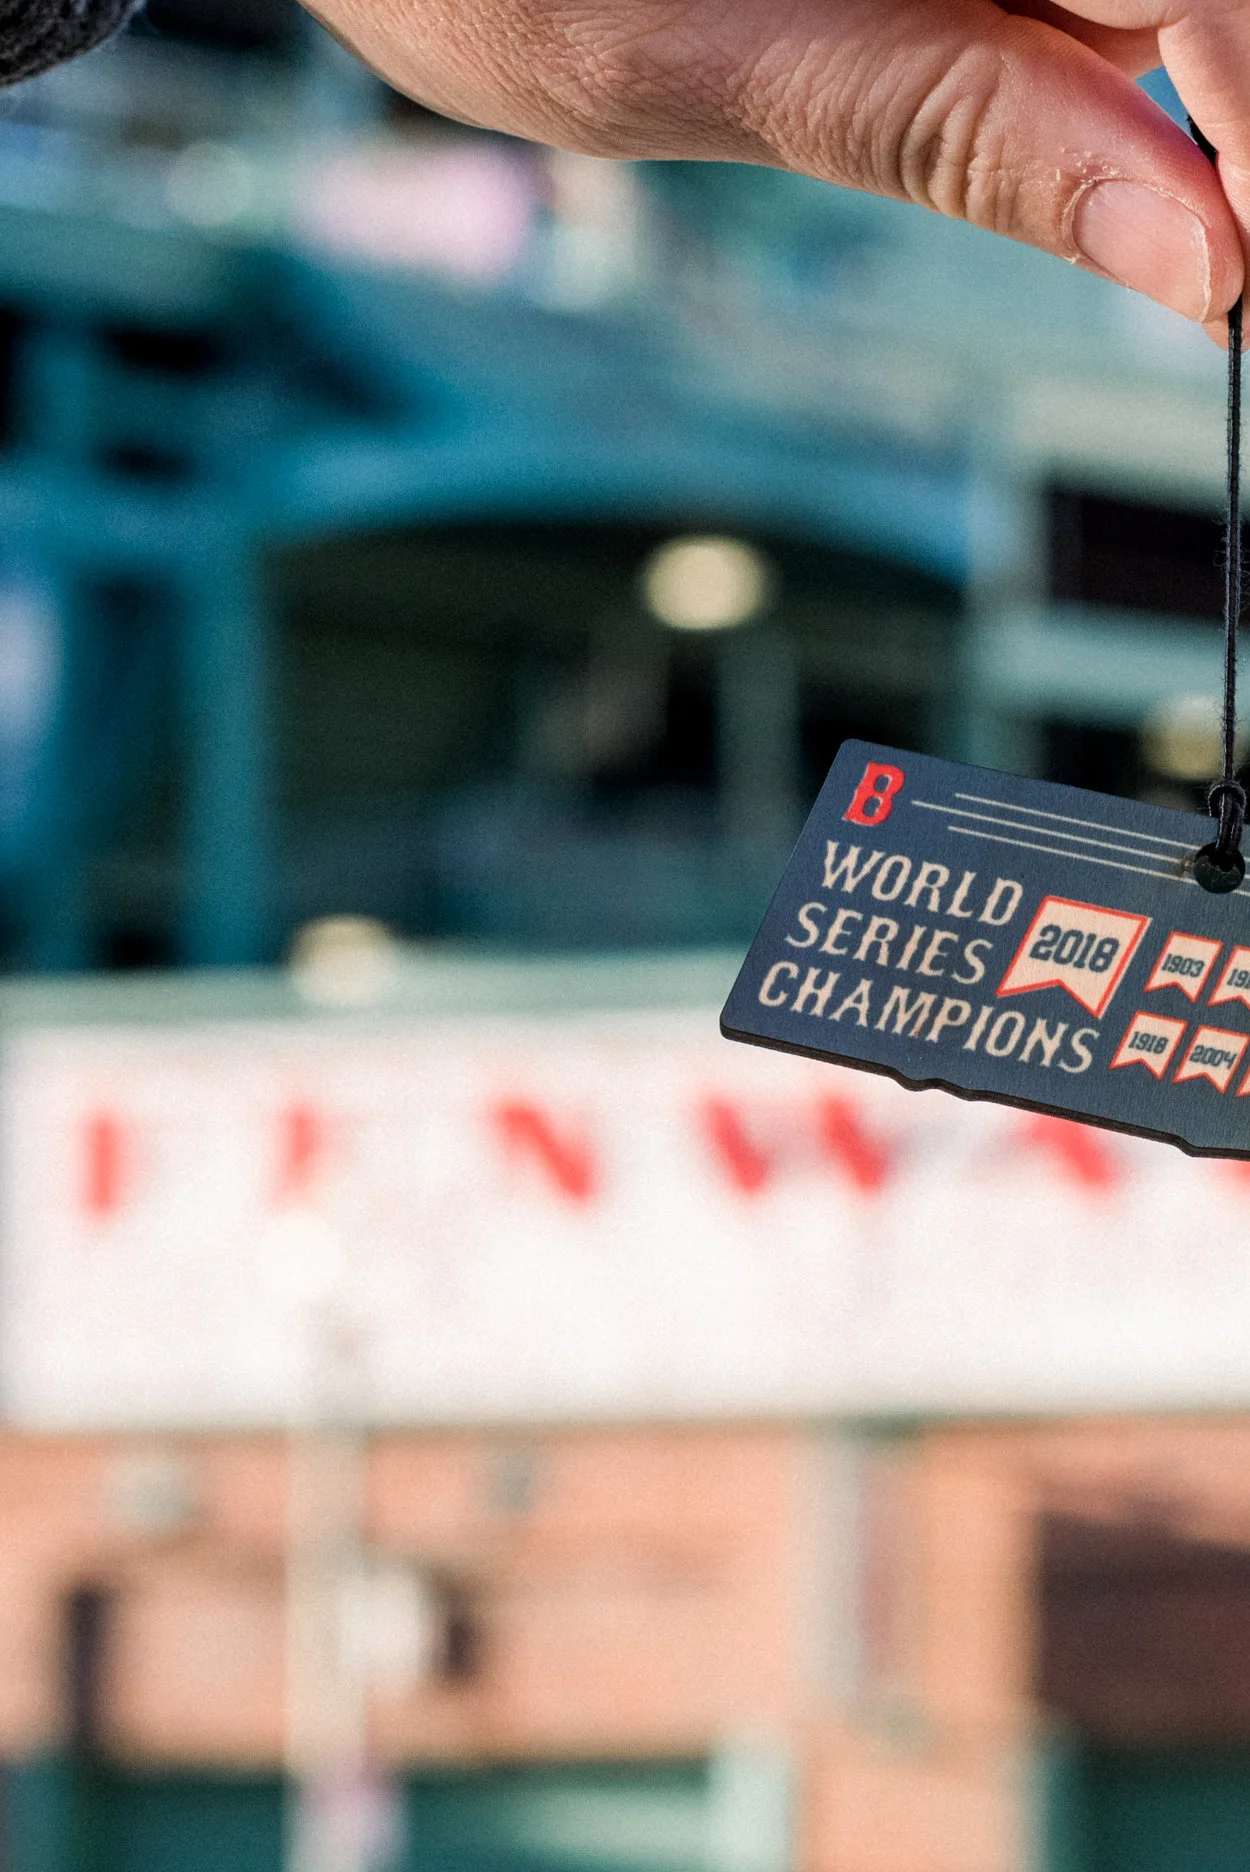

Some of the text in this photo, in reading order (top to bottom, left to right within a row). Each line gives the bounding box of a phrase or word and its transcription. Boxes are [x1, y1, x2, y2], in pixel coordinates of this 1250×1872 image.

[842, 762, 904, 826] B
[821, 840, 1023, 926] WORLD
[784, 902, 993, 985] SERIES
[1029, 924, 1120, 973] 2018
[1161, 953, 1205, 978] 1903
[758, 961, 1100, 1073] CHAMPIONS
[1128, 1031, 1168, 1055] 1918
[1189, 1044, 1237, 1070] 2004
